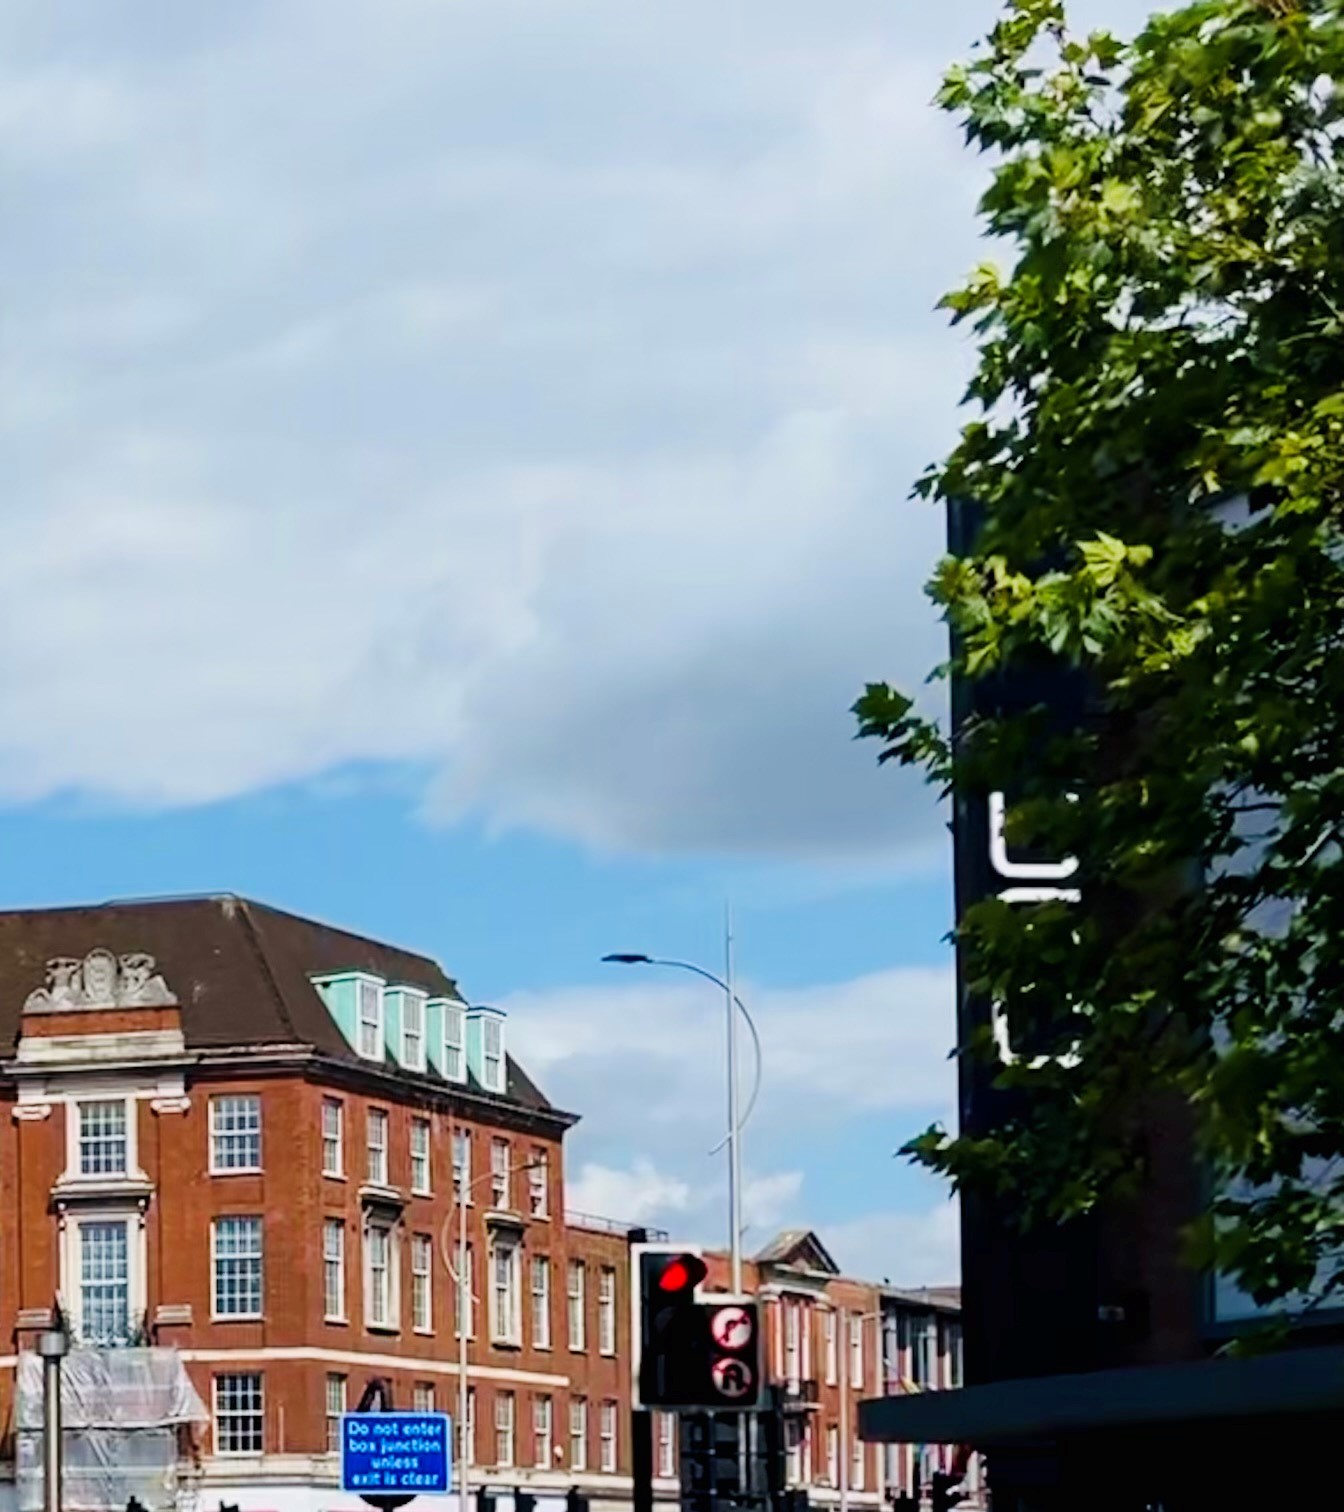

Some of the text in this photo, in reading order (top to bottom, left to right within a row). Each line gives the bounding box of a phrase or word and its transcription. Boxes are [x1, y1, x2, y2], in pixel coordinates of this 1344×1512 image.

[348, 1421, 442, 1436] Do not enter
[348, 1438, 441, 1455] box junction
[371, 1456, 419, 1470] unless
[401, 1471, 439, 1486] clear
